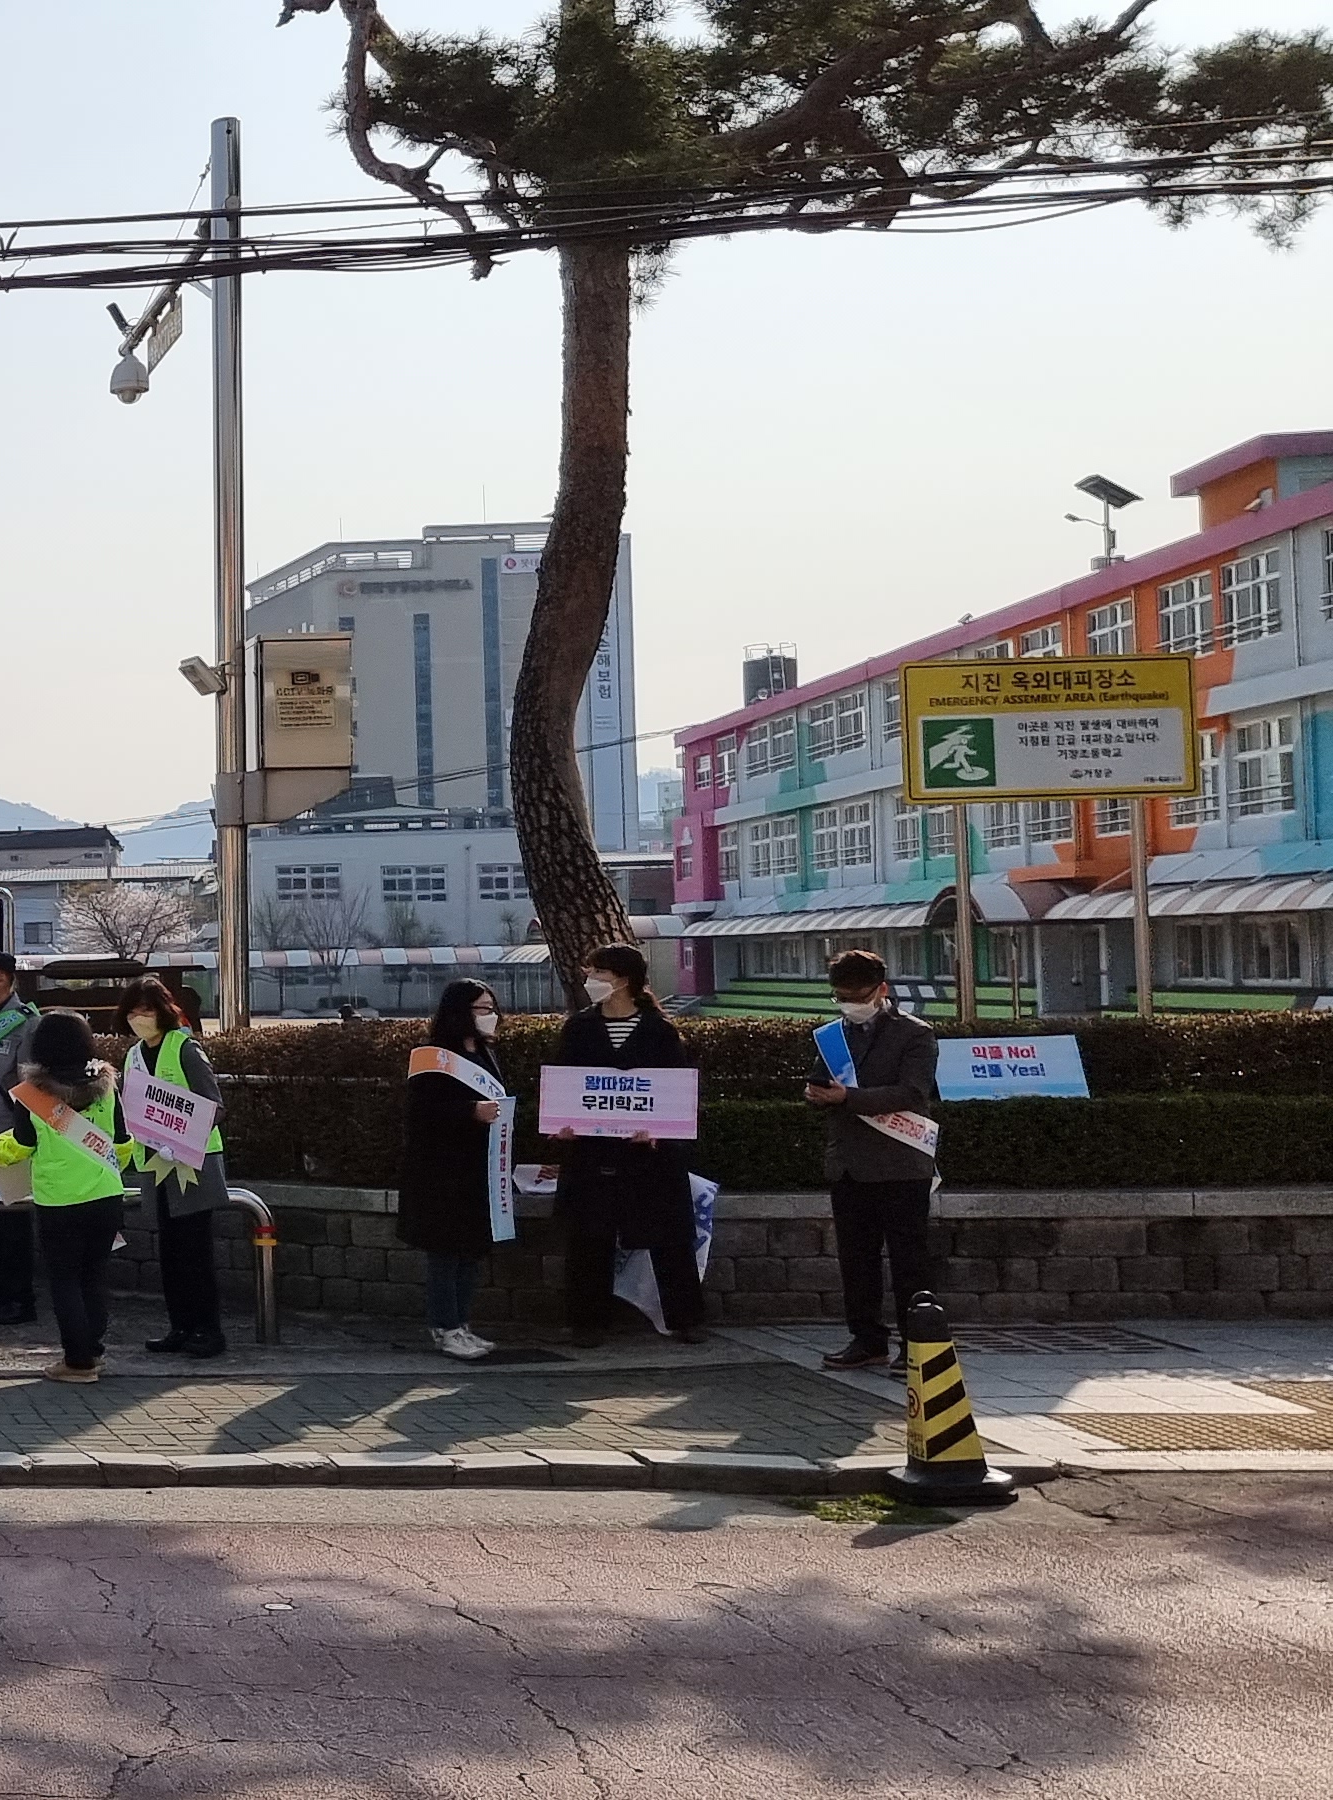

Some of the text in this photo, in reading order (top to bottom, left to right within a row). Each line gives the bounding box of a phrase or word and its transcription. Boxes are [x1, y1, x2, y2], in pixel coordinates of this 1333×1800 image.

[961, 669, 1137, 693] 지진 옥외대피장소
[928, 690, 1170, 707] EMERGENCY ASSEMBLY AREA (Earthquake)
[1007, 1044, 1037, 1059] No!
[1006, 1062, 1046, 1077] Yes!
[585, 1075, 652, 1092] 왕따없는
[144, 1084, 195, 1117] 사이버폭력
[582, 1095, 654, 1112] 우리학교!
[144, 1104, 188, 1135] 로그아웃!
